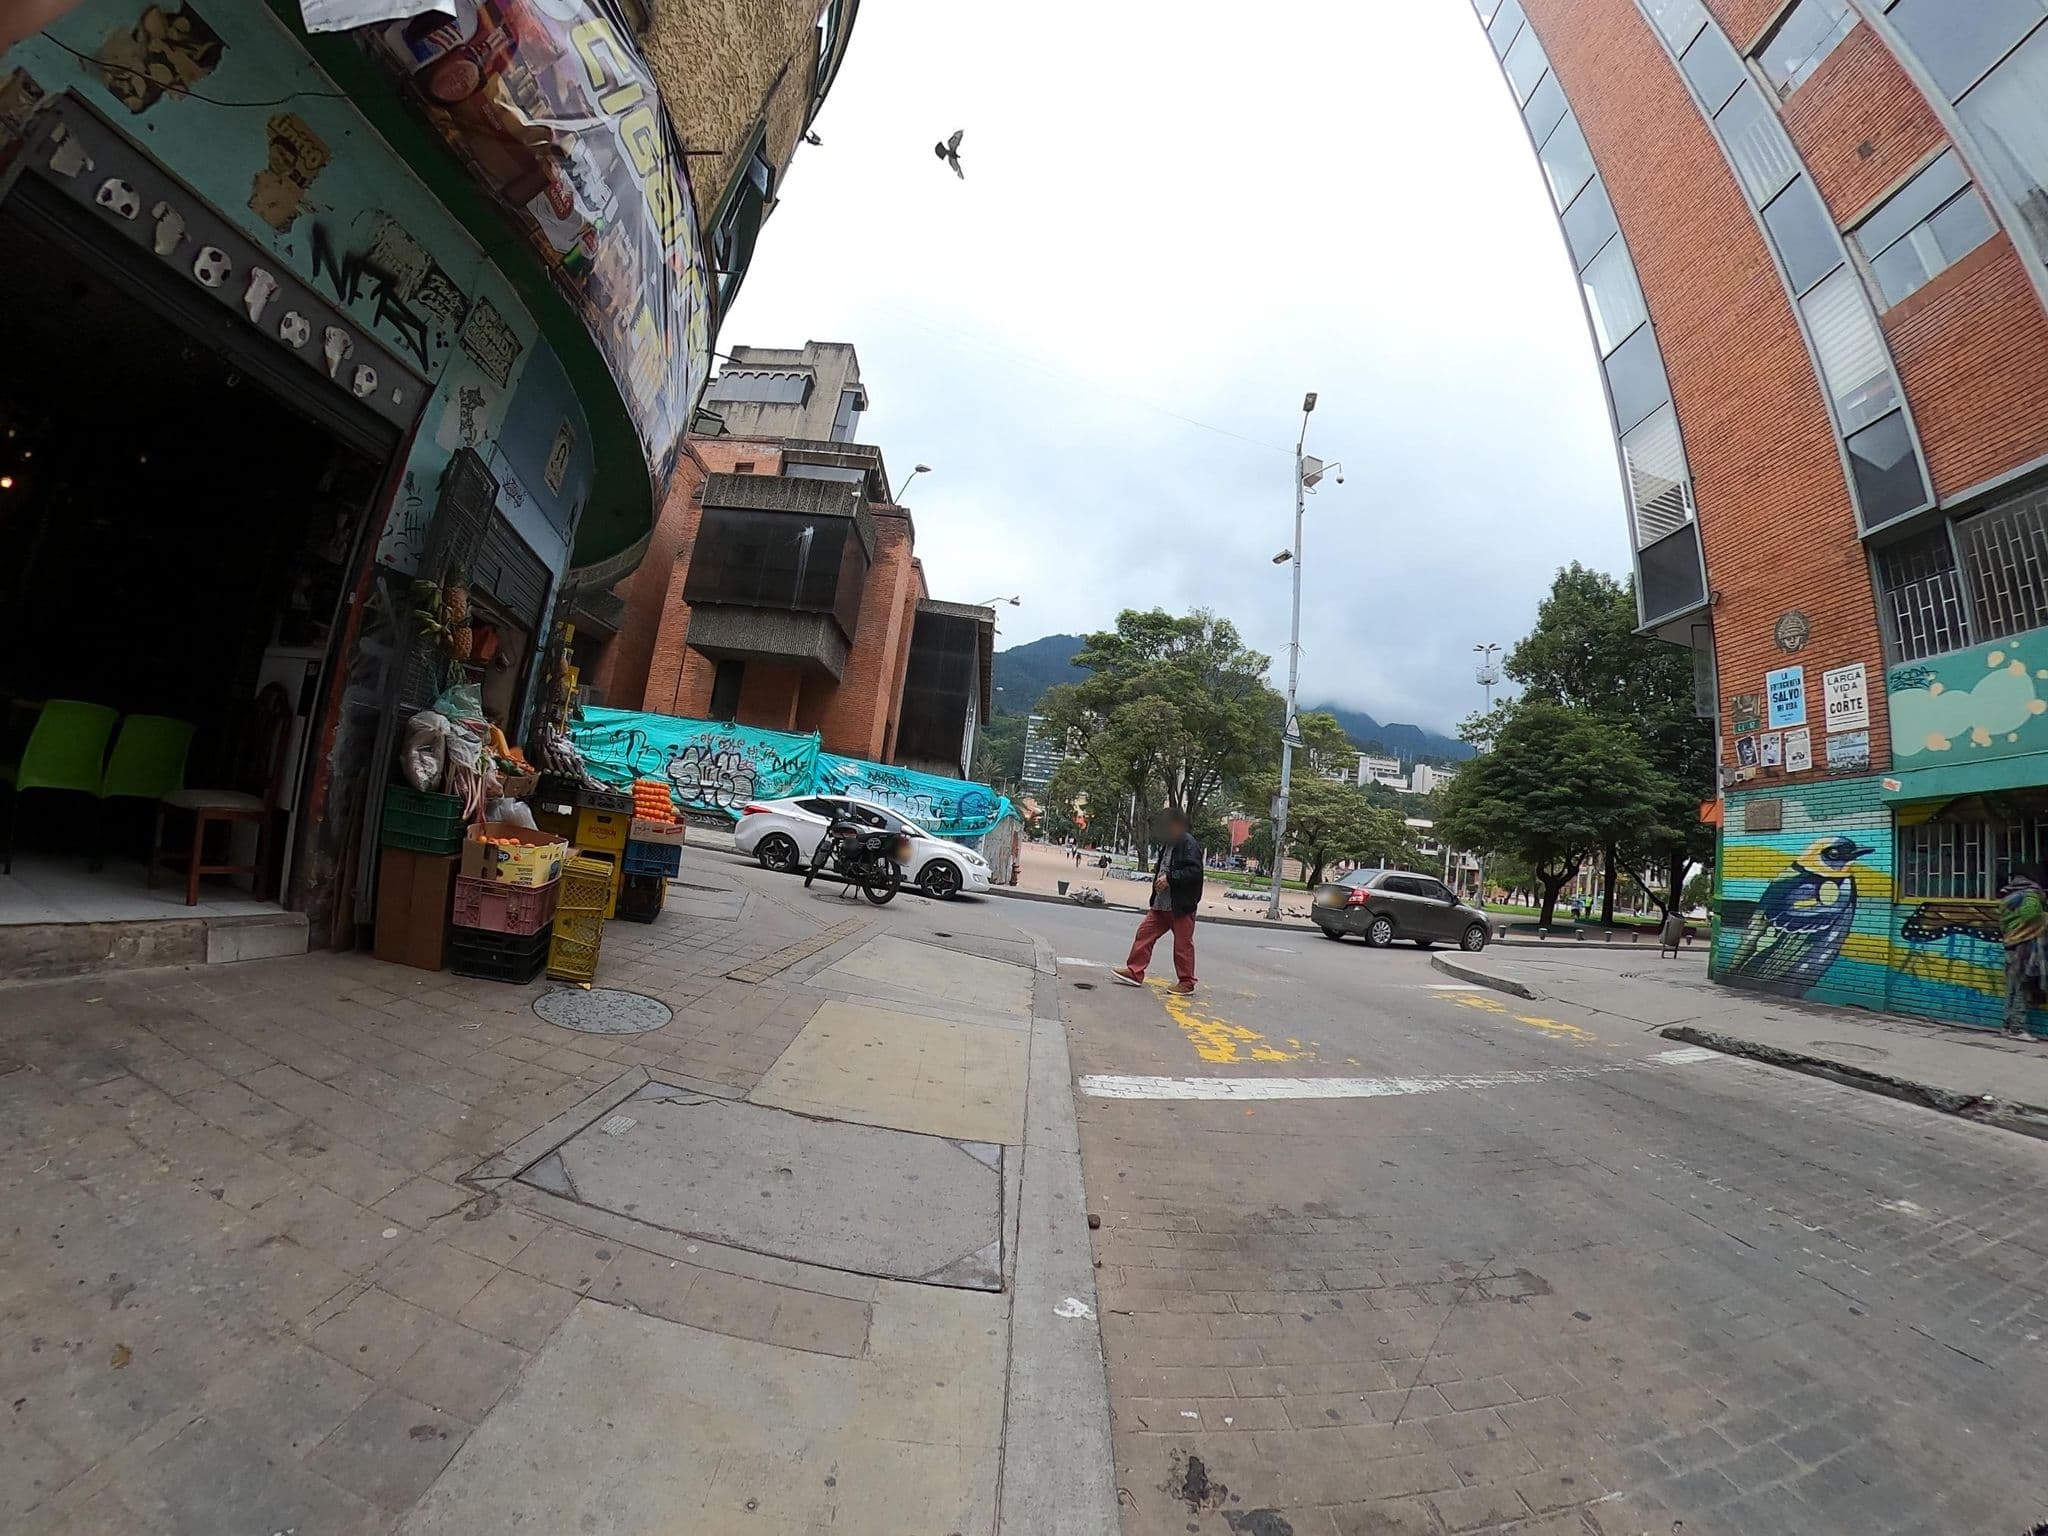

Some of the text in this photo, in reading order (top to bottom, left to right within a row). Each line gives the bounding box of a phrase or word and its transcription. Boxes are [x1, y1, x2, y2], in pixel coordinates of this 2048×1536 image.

[1827, 671, 1861, 686] LARGA
[1833, 682, 1857, 693] VIDA
[1772, 688, 1799, 703] SALVO
[1830, 697, 1863, 714] CORTE
